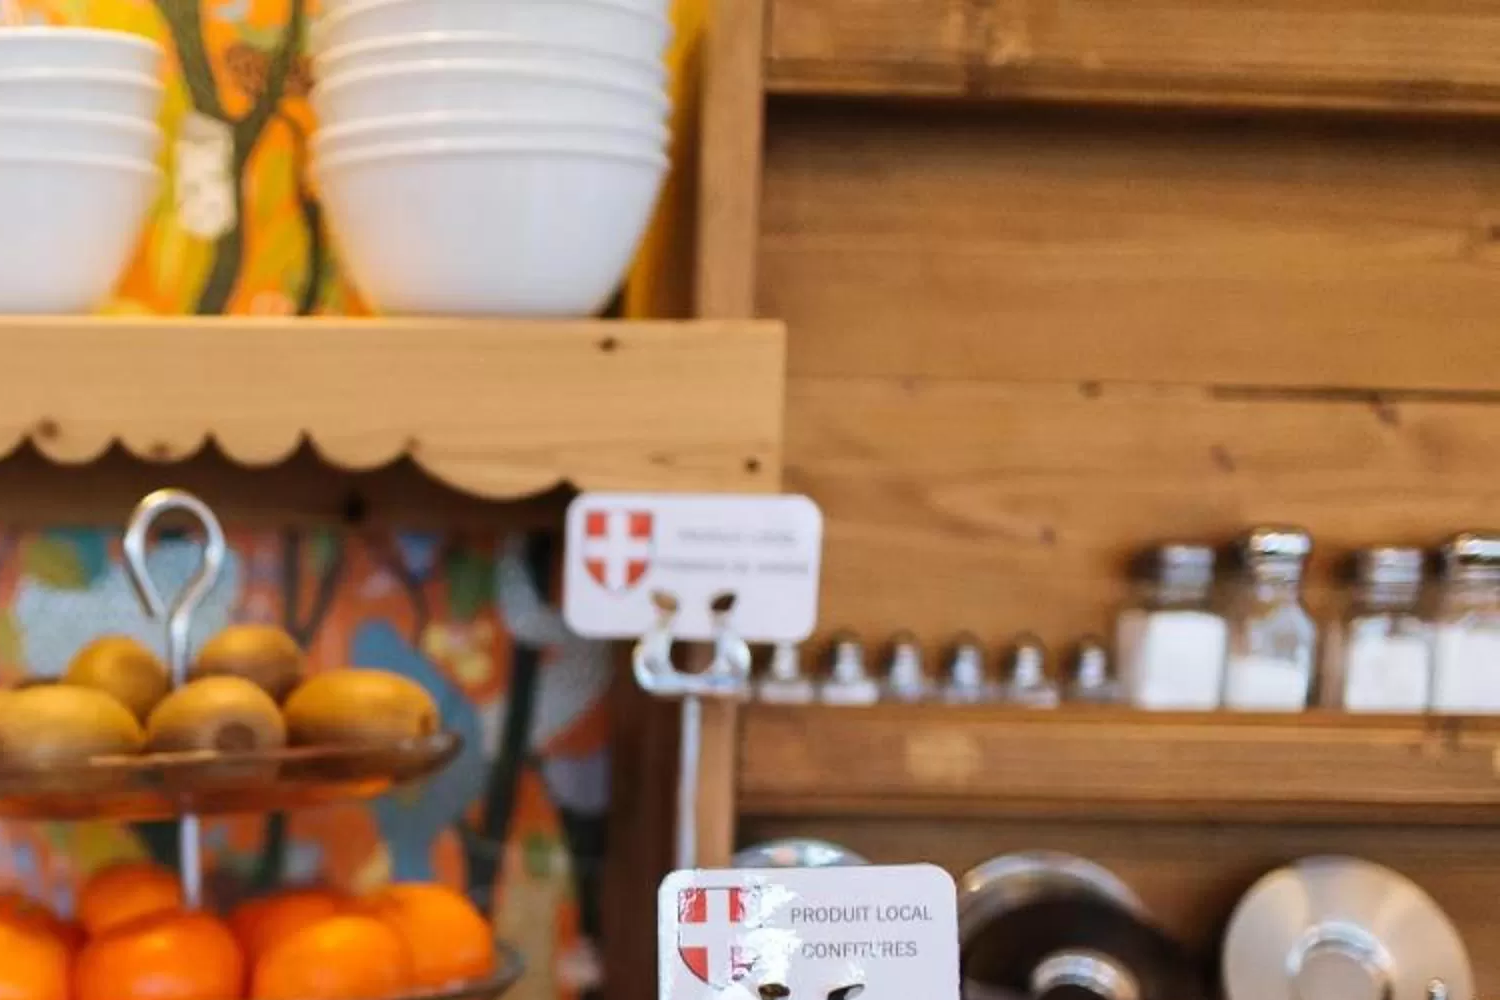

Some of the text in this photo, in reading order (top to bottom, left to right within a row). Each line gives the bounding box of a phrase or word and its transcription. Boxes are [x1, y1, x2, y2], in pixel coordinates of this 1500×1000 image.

[791, 904, 933, 924] PRODUIT LOCAL
[801, 940, 918, 960] CONFITURES
